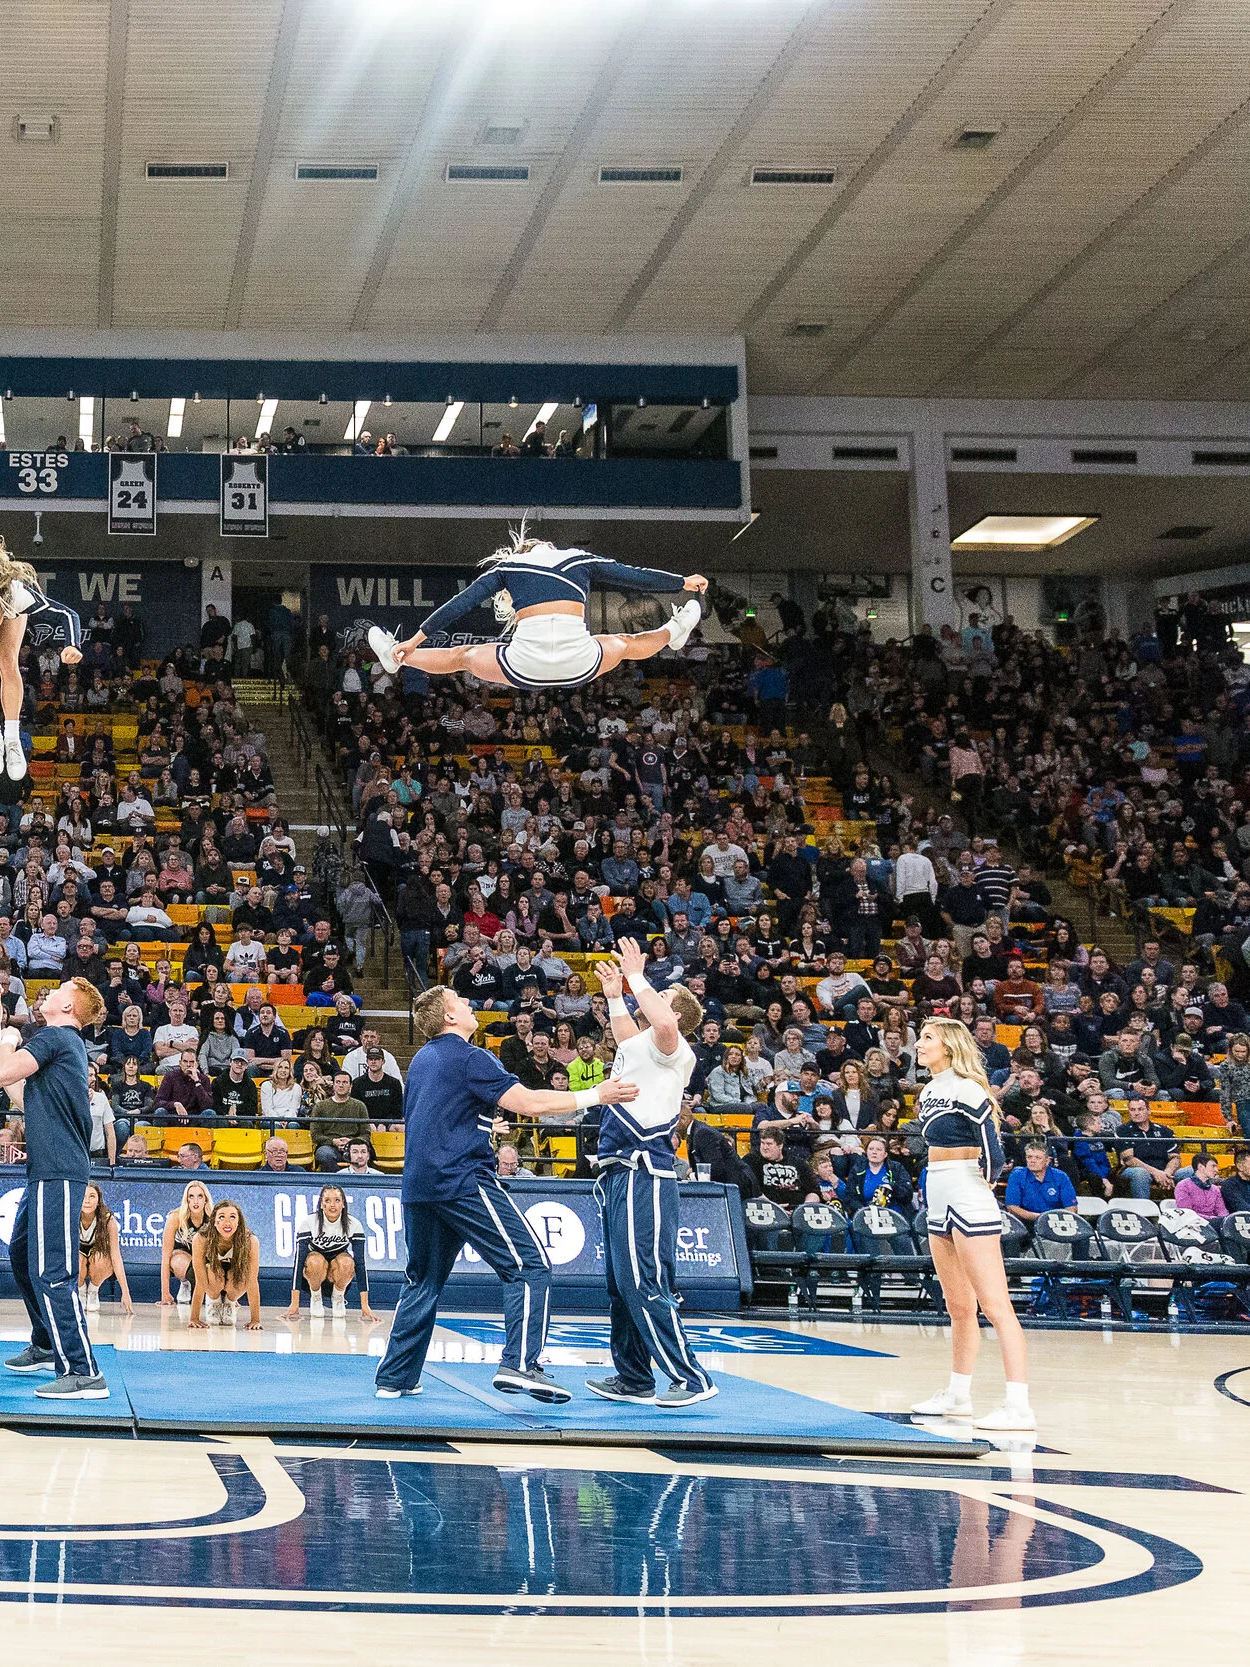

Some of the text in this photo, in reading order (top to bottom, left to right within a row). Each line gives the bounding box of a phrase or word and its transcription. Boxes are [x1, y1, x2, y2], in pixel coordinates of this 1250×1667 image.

[9, 453, 69, 468] ESTES
[18, 468, 58, 493] 33
[117, 491, 148, 509] 24
[231, 492, 258, 510] 31
[210, 566, 224, 581] A
[78, 573, 142, 601] WE
[336, 577, 435, 607] WILL
[315, 1231, 347, 1247] Aggies
[540, 1215, 563, 1248] F
